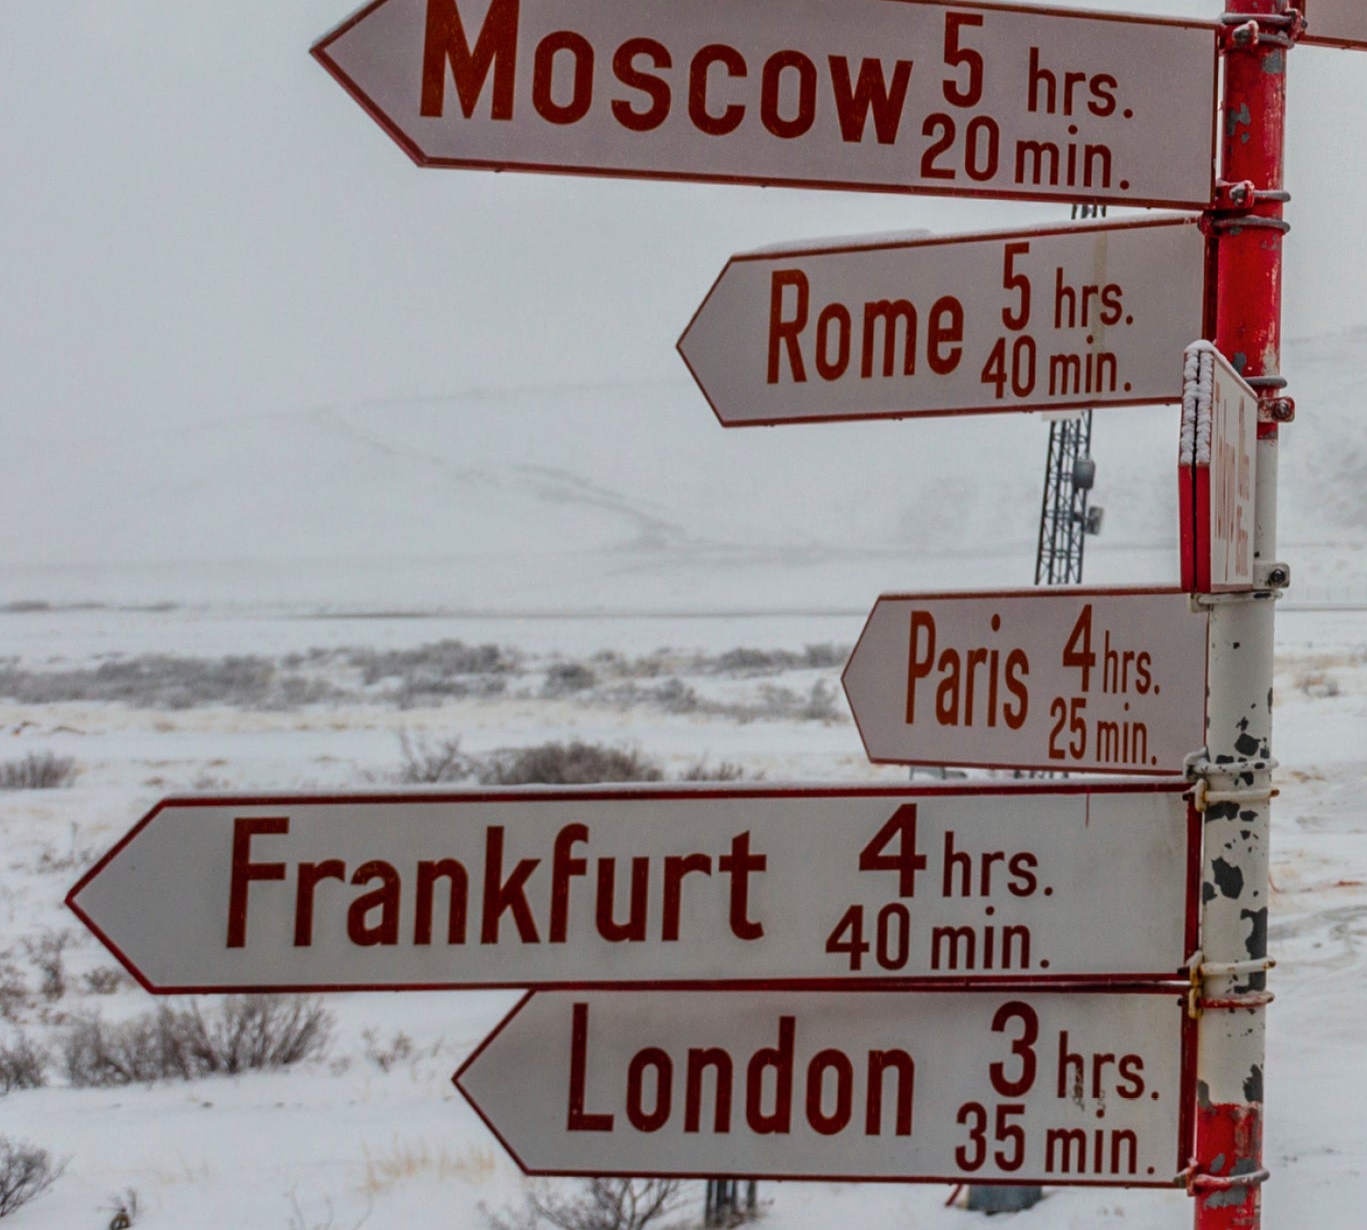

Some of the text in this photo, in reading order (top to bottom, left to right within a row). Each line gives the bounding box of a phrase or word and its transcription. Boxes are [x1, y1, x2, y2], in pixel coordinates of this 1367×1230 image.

[942, 10, 985, 109] 5
[1027, 46, 1134, 119] hrs.
[919, 111, 1130, 191] 20 min.
[766, 242, 1133, 385] Rome 5 hrs.
[980, 334, 1132, 399] 40 min.
[905, 603, 1161, 731] Paris 4 hrs.
[1048, 696, 1158, 767] 25 min.
[227, 803, 1053, 948] Frankfurt 4 hrs.
[826, 902, 1050, 971] 40 min.
[567, 1001, 1161, 1136] London 3 hrs.
[955, 1101, 1155, 1175] 35 min.
